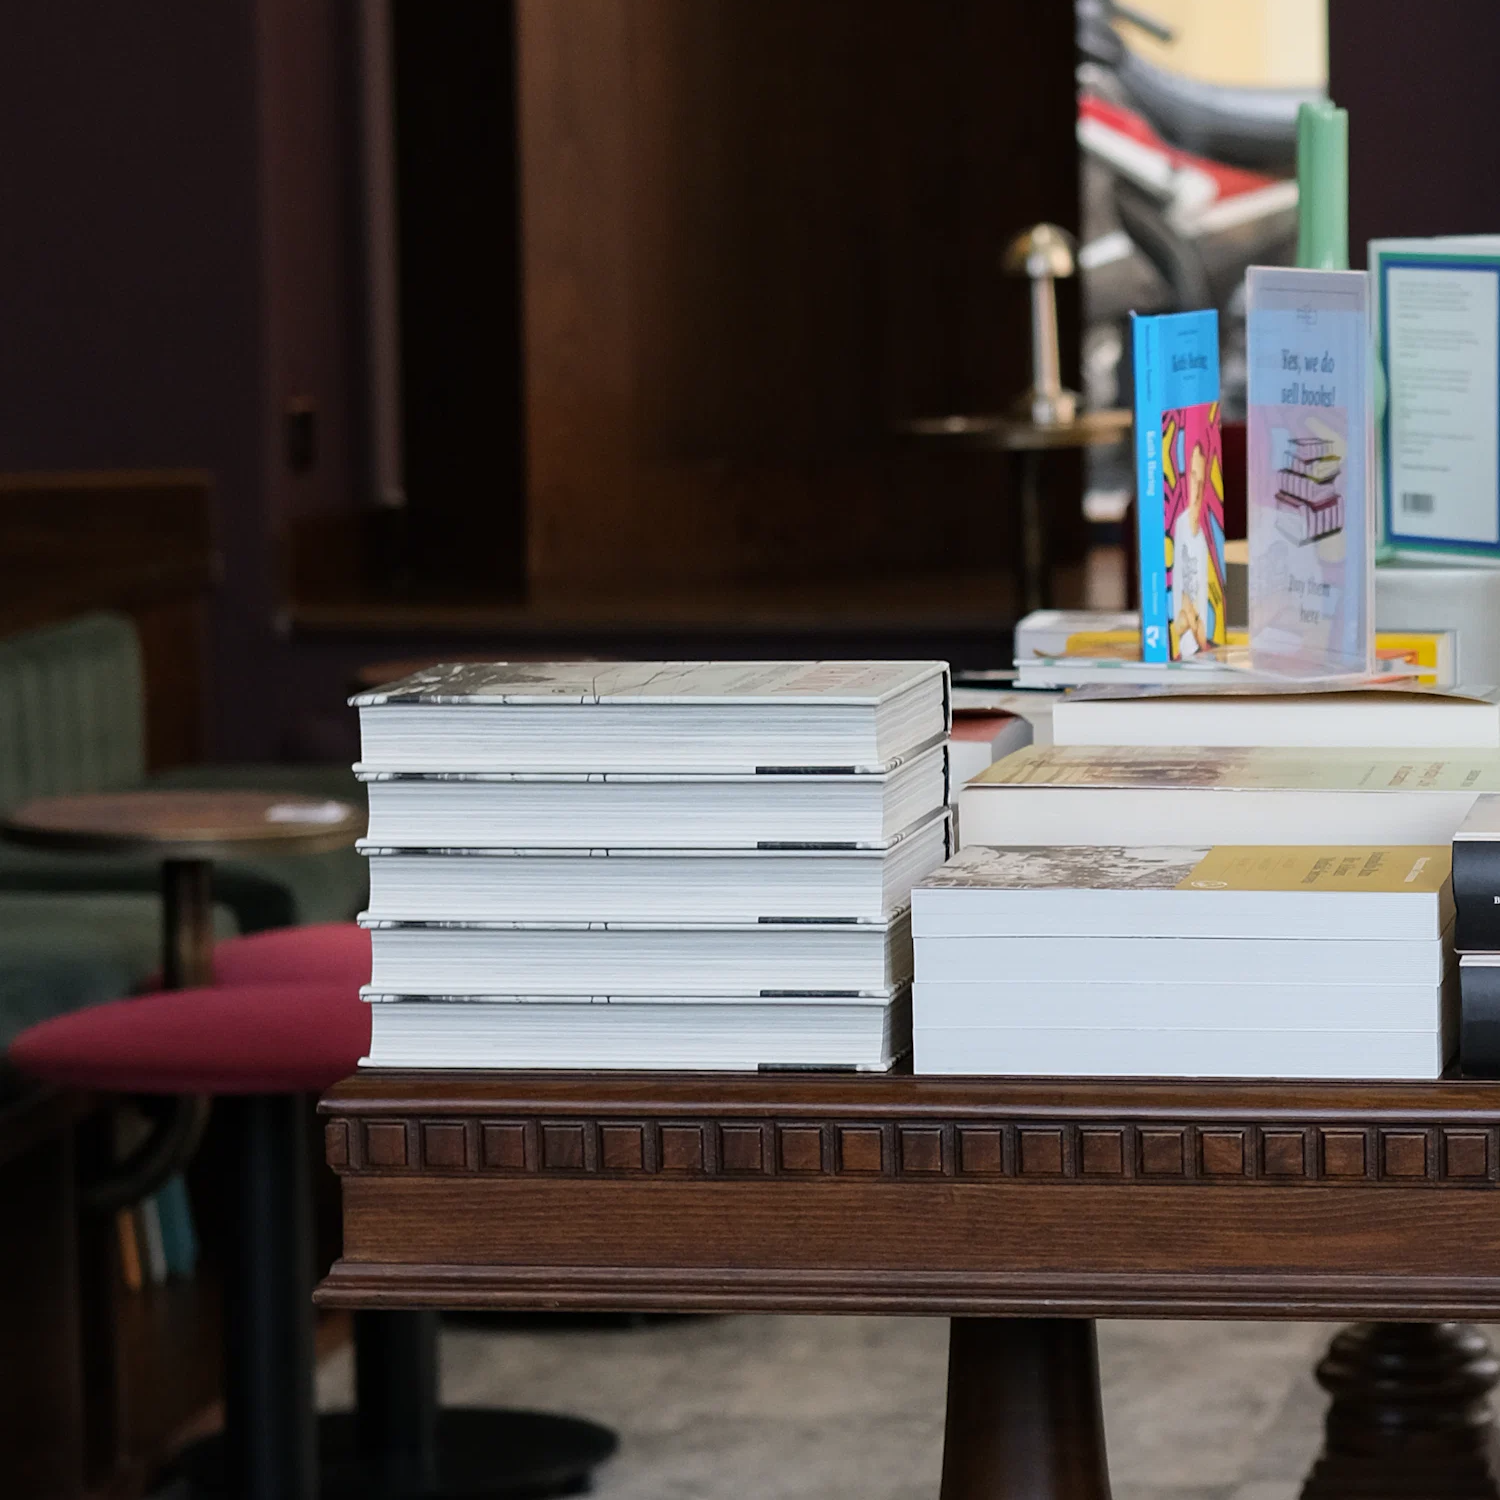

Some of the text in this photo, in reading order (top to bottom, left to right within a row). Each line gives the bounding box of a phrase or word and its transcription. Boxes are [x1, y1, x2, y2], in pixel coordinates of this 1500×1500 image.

[1280, 349, 1335, 375] Yes, we do
[1281, 382, 1336, 408] sell books!
